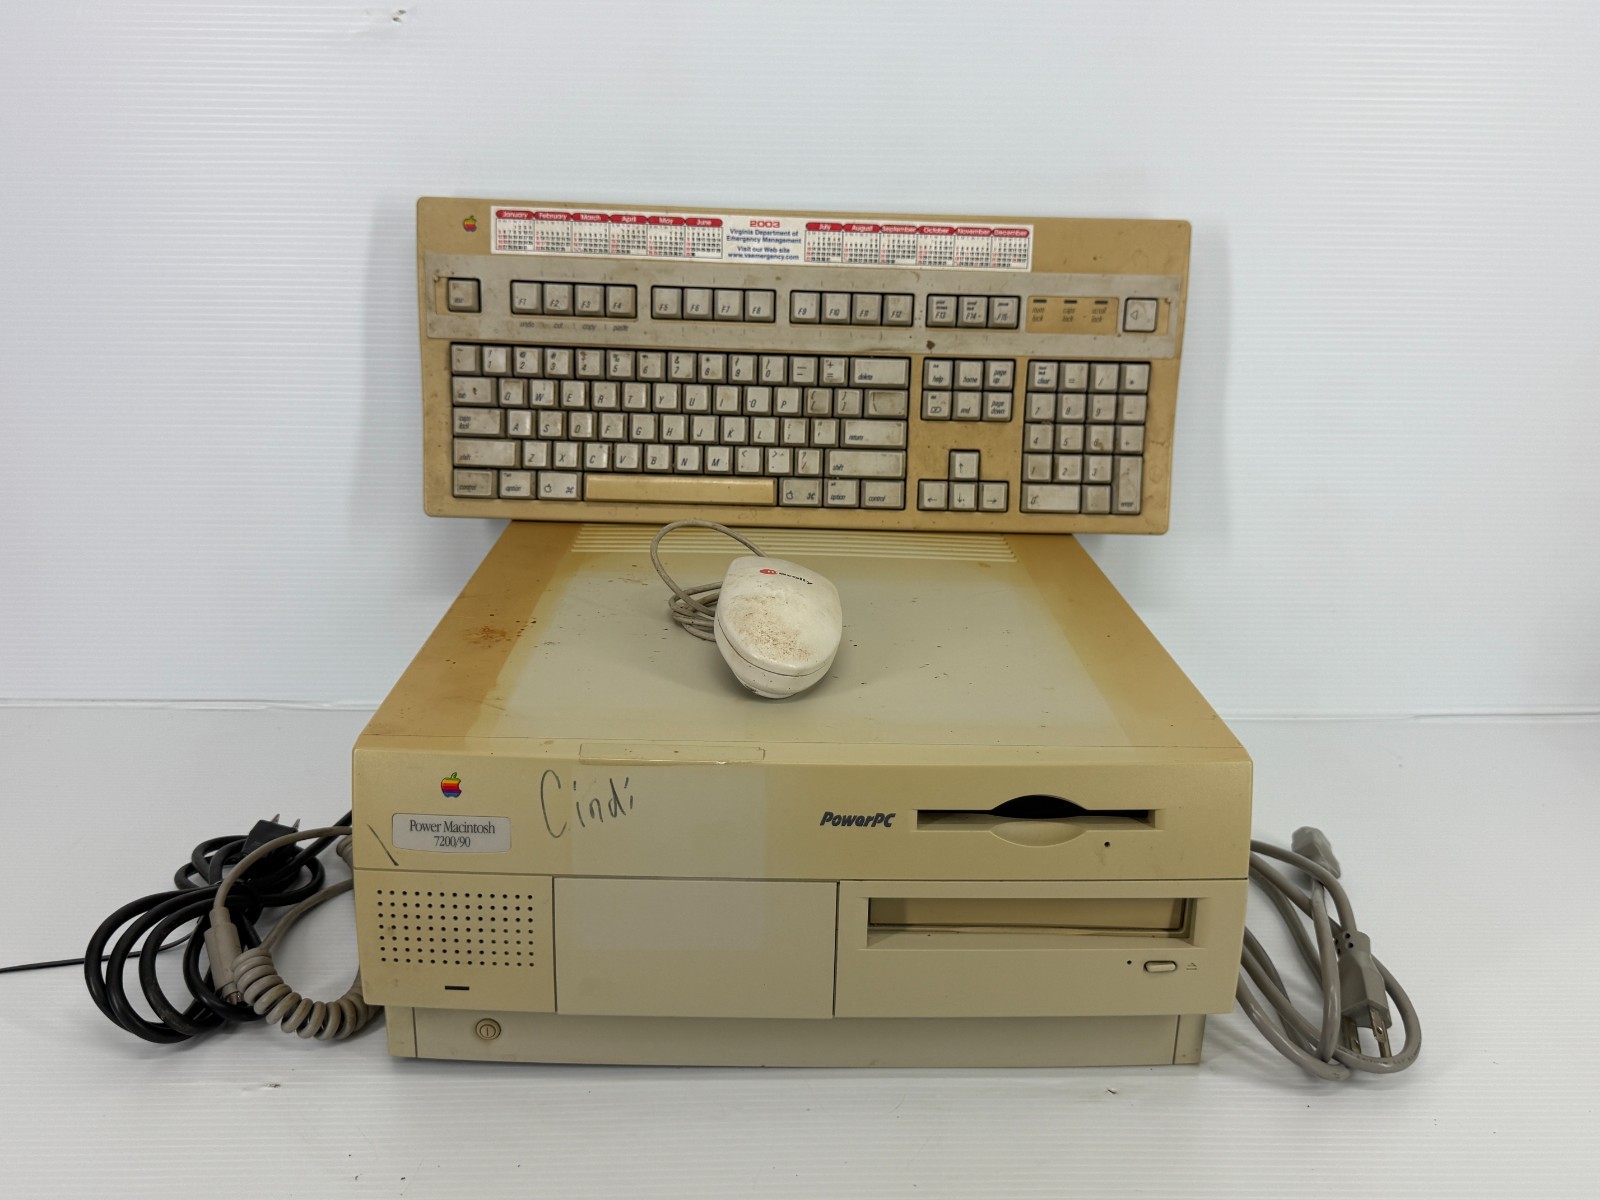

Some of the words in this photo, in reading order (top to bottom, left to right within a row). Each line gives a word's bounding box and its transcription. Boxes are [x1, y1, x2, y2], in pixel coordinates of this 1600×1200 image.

[503, 211, 528, 219] January
[539, 212, 567, 220] February
[659, 217, 673, 225] May
[750, 220, 780, 228] 2003
[819, 223, 831, 231] July
[755, 229, 791, 237] Department
[518, 298, 527, 306] F1
[550, 300, 559, 308] F2
[581, 301, 591, 309] F3
[612, 302, 622, 310] F4
[690, 304, 700, 312] F6
[752, 306, 761, 314] F8
[798, 308, 808, 316] F9
[829, 308, 840, 316] F10
[859, 309, 869, 317] F11
[935, 311, 946, 319] F13
[966, 312, 977, 320] F14
[520, 361, 526, 369] 2
[551, 363, 556, 371] 3
[613, 364, 618, 372] 5
[643, 366, 648, 374] 6
[674, 366, 680, 375] 7
[932, 375, 944, 383] help
[535, 393, 544, 401] W
[567, 393, 573, 402] E
[597, 395, 604, 404] R
[628, 395, 633, 404] T
[659, 396, 665, 404] Y
[689, 398, 695, 407] U
[781, 400, 787, 409] P
[513, 423, 519, 431] A
[544, 424, 550, 433] S
[605, 425, 611, 434] F
[636, 427, 642, 436] G
[666, 428, 673, 436] H
[697, 428, 703, 437] J
[727, 429, 734, 438] K
[757, 430, 762, 439] L
[1063, 437, 1068, 446] 5
[528, 453, 535, 462] Z
[560, 454, 566, 462] X
[590, 455, 596, 464] C
[620, 455, 626, 464] V
[651, 456, 657, 465] B
[681, 458, 687, 466] N
[712, 458, 720, 466] M
[540, 769, 633, 838] Cindi
[819, 811, 896, 828] PowerPC
[409, 819, 442, 833] Power
[443, 820, 495, 834] Macintosh
[433, 835, 471, 848] 7200/90
